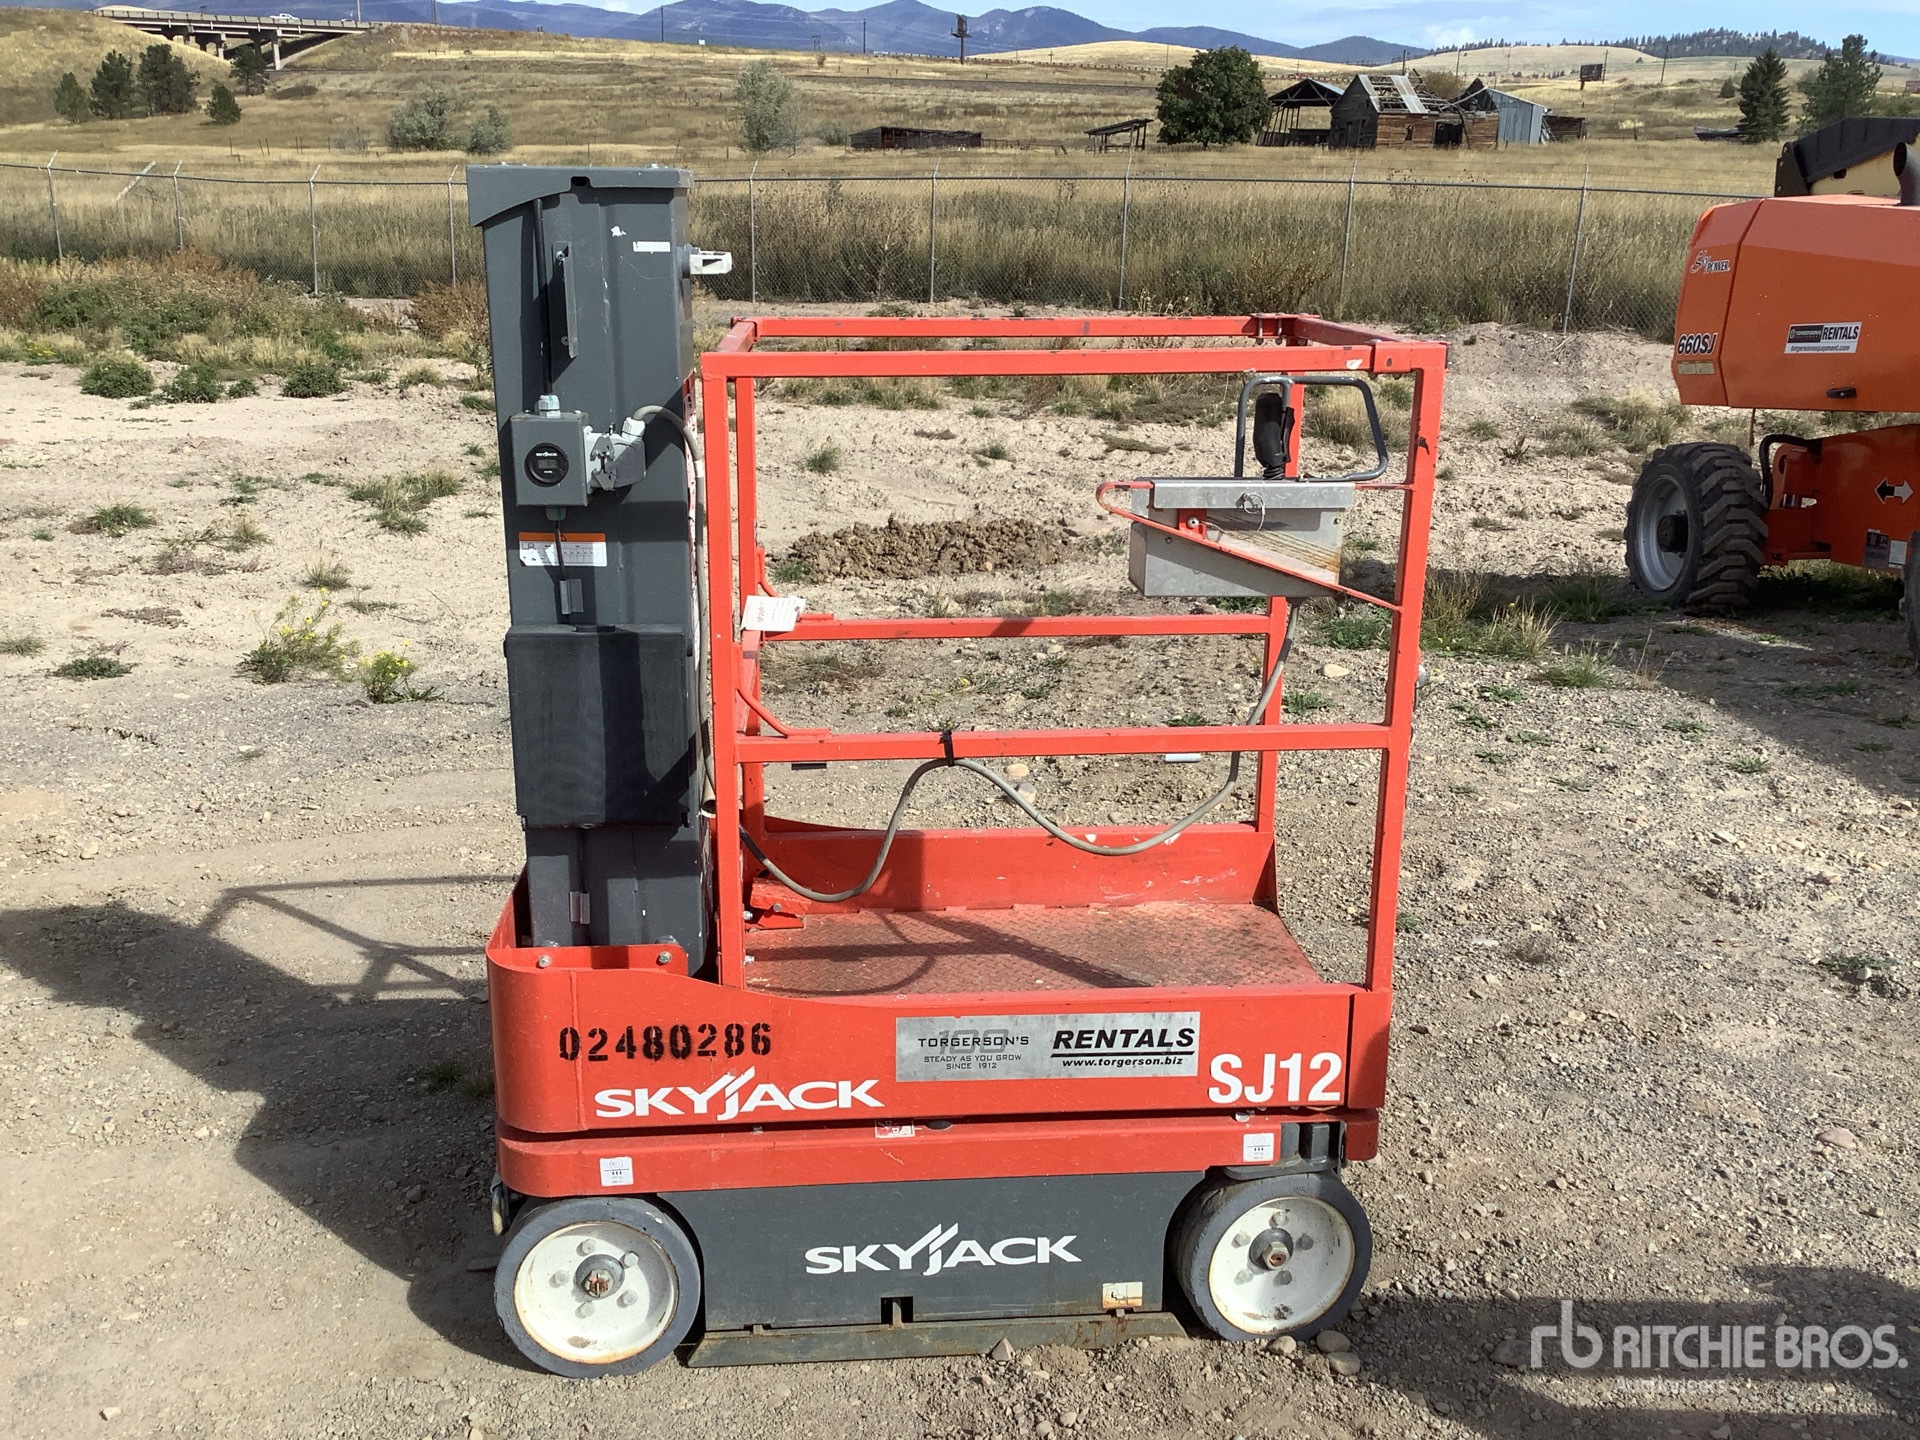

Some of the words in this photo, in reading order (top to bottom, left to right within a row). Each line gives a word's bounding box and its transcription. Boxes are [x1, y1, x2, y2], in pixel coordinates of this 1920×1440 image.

[1677, 333, 1718, 355] 660SJ
[1822, 325, 1859, 341] RENTALS
[558, 1022, 773, 1063] 02480286
[917, 1035, 1030, 1048] TORGERSON'S
[1052, 1027, 1196, 1049] RENTALS
[923, 1055, 958, 1063] STEADY
[975, 1054, 993, 1062] YOU
[996, 1053, 1022, 1061] GROW
[945, 1062, 972, 1070] SINCE
[1062, 1056, 1184, 1068] www.torgerson.biz
[1207, 1051, 1343, 1104] SJ12
[594, 1065, 886, 1122] SKYJACK
[804, 1222, 1083, 1277] SKYJACK
